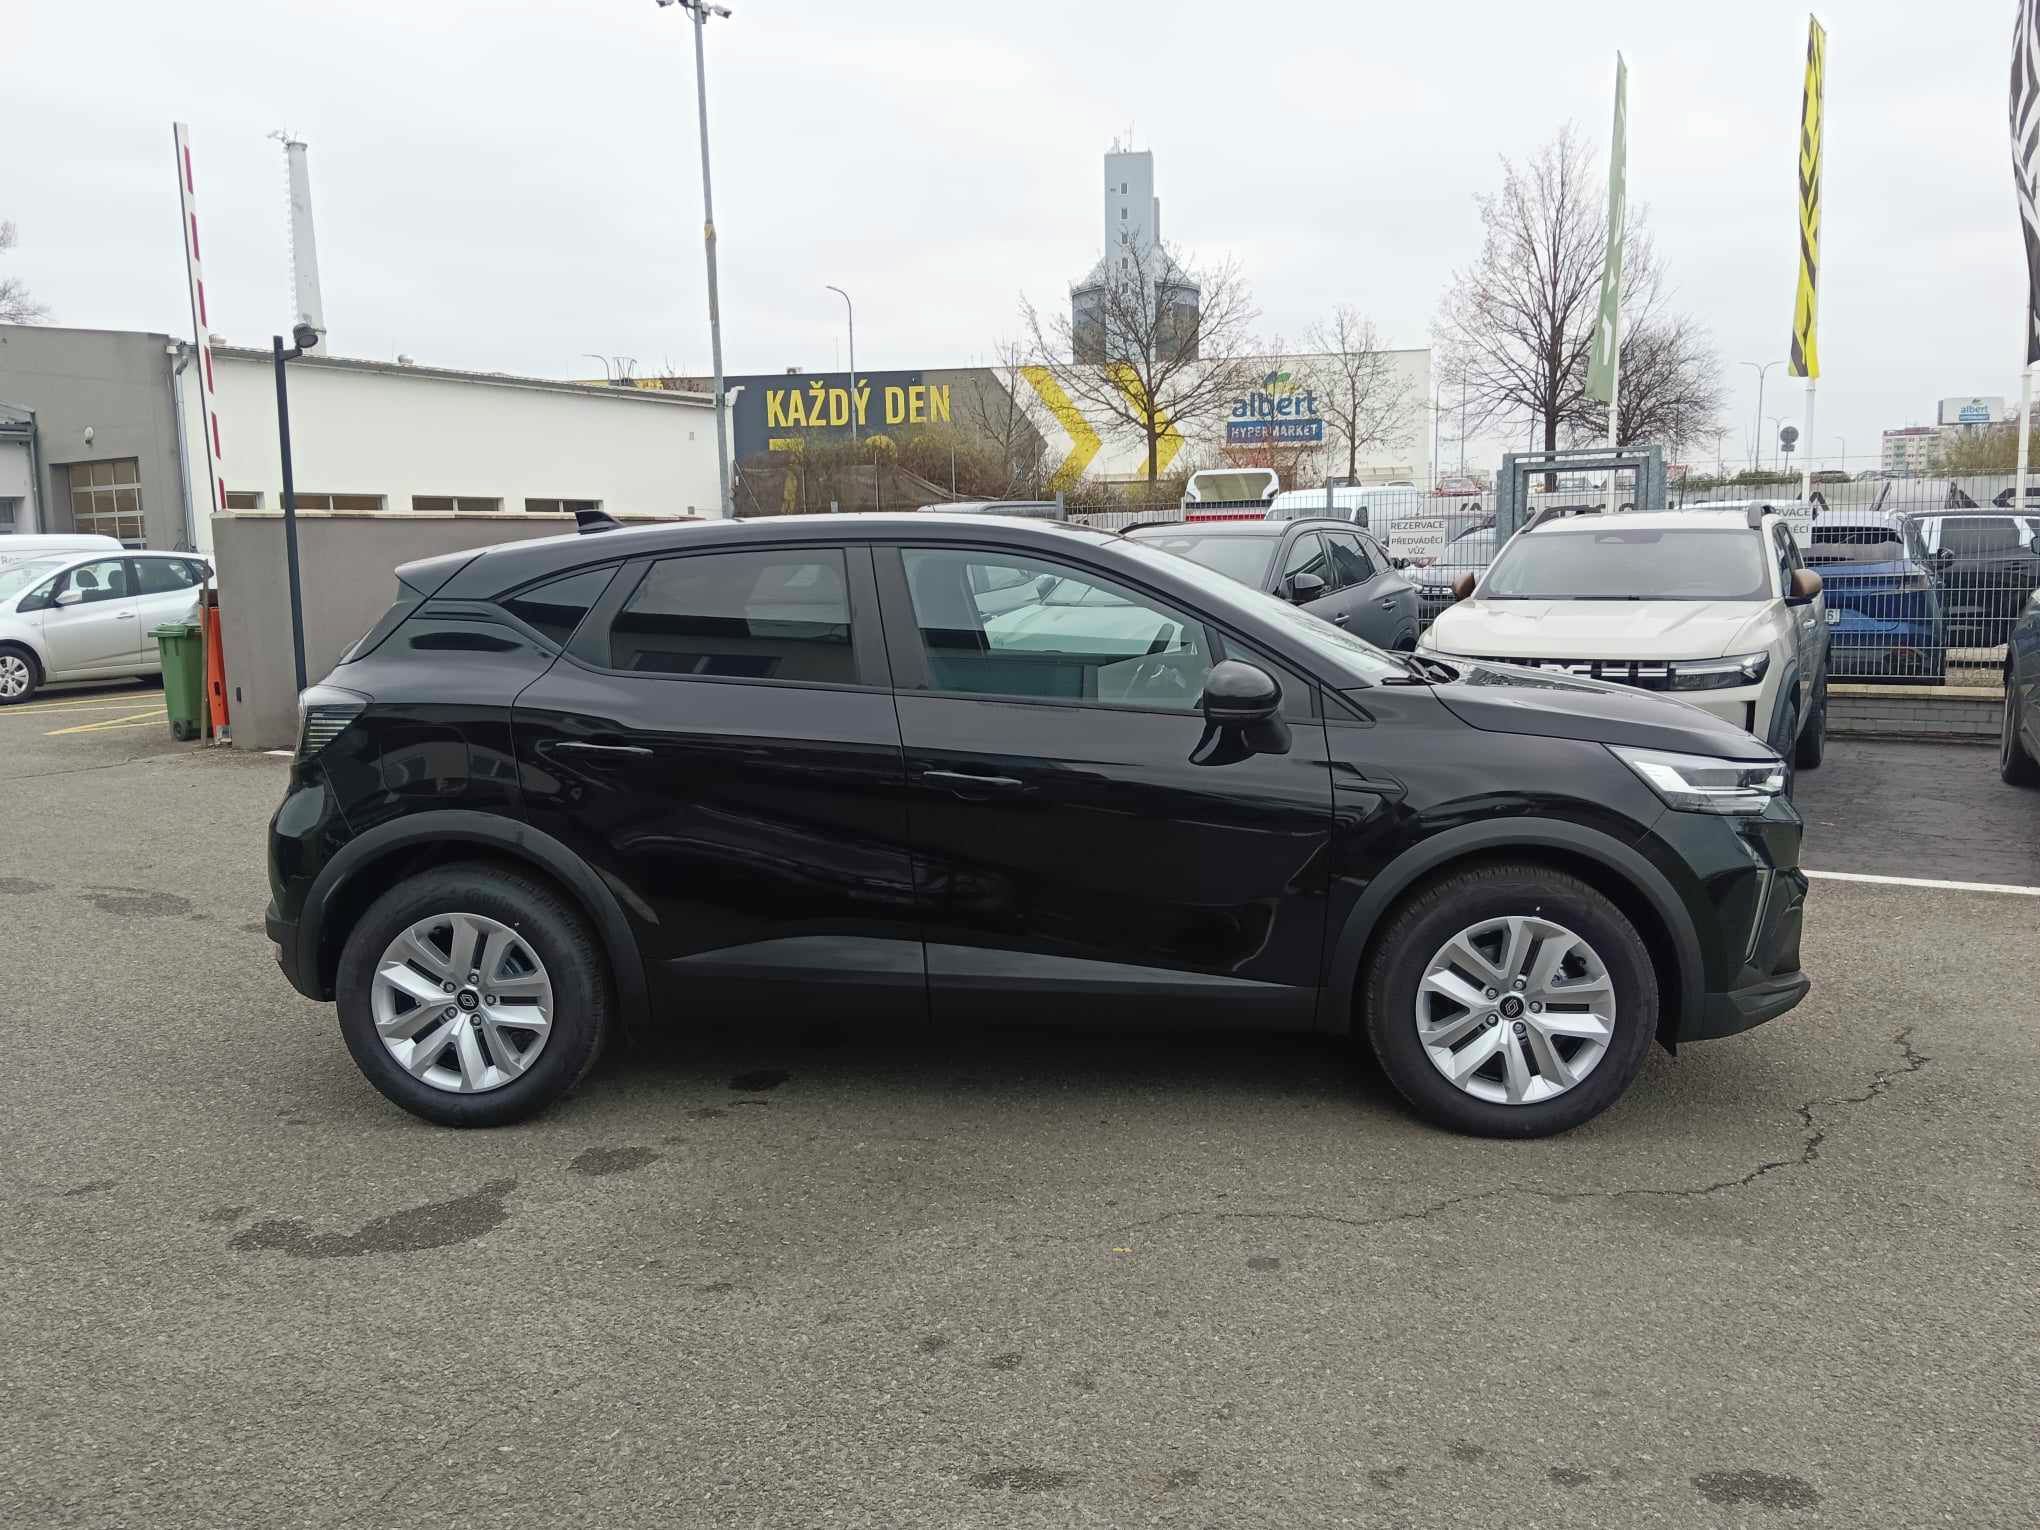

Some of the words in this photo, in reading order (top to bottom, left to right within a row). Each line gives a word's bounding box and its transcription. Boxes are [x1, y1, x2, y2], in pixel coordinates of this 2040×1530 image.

[766, 379, 871, 428] KAŽDÝ
[884, 384, 951, 425] DEN
[1231, 390, 1318, 418] albert
[1231, 423, 1318, 439] HYPERMARKET
[1391, 520, 1445, 530] REZERVACE
